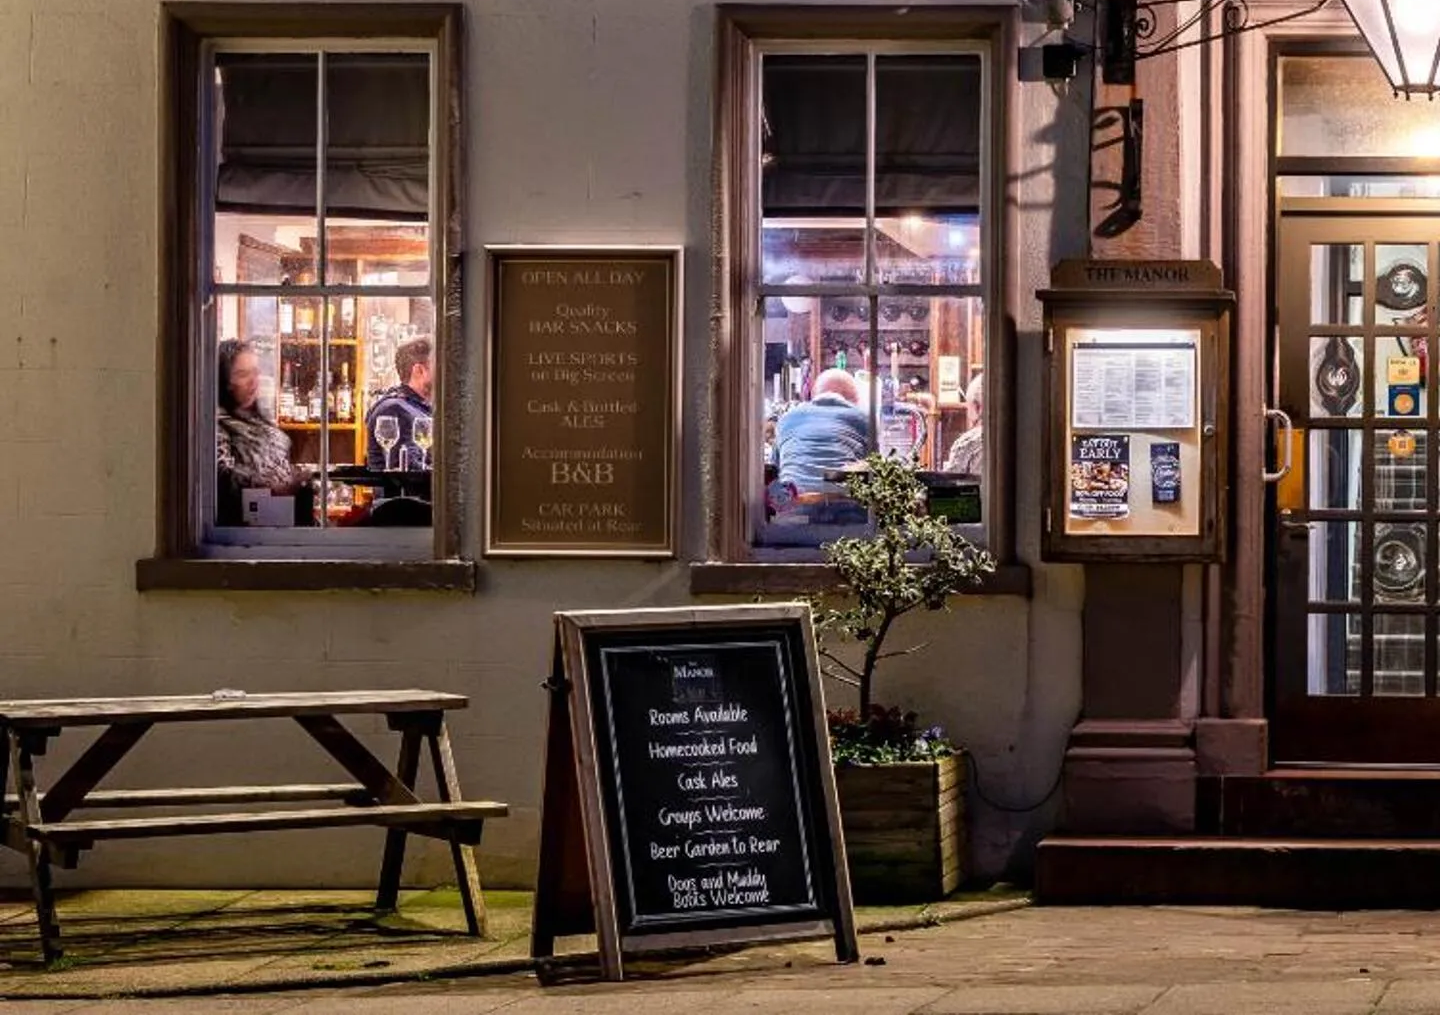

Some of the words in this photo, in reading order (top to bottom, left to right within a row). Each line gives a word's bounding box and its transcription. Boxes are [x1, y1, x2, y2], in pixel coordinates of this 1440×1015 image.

[521, 270, 568, 285] OPEN
[573, 270, 604, 285] ALL
[609, 270, 646, 285] DAY
[1084, 267, 1120, 282] THE
[1124, 266, 1190, 283] MANOR
[556, 303, 610, 320] Quality
[528, 321, 565, 334] BAR
[569, 321, 638, 334] SNACKS
[528, 352, 566, 365] LIVE
[569, 352, 638, 365] SPORTS
[531, 371, 550, 381] on
[554, 368, 580, 385] Big
[582, 368, 635, 382] Screen
[527, 399, 561, 414] Cask
[583, 399, 638, 414] Bottled
[561, 415, 605, 428] ALES
[1079, 448, 1121, 459] EARLY
[551, 462, 615, 485] B&B
[538, 503, 575, 517] CAR
[579, 503, 626, 517] PARK
[648, 708, 690, 725] Rooms
[694, 702, 749, 724] Available
[648, 737, 726, 760] Homecooked
[728, 733, 758, 755] Food
[677, 770, 708, 791] Cask
[711, 768, 739, 789] Ales
[658, 806, 703, 830] Groups
[704, 802, 766, 823] Welcome
[650, 841, 681, 860] Beer
[684, 836, 731, 859] Garden
[732, 835, 747, 855] to
[748, 835, 781, 854] Rear
[667, 874, 697, 893] Dogs
[700, 869, 724, 890] and
[726, 866, 768, 890] Muddy
[673, 890, 708, 909] Boots
[710, 885, 770, 906] Welcome
